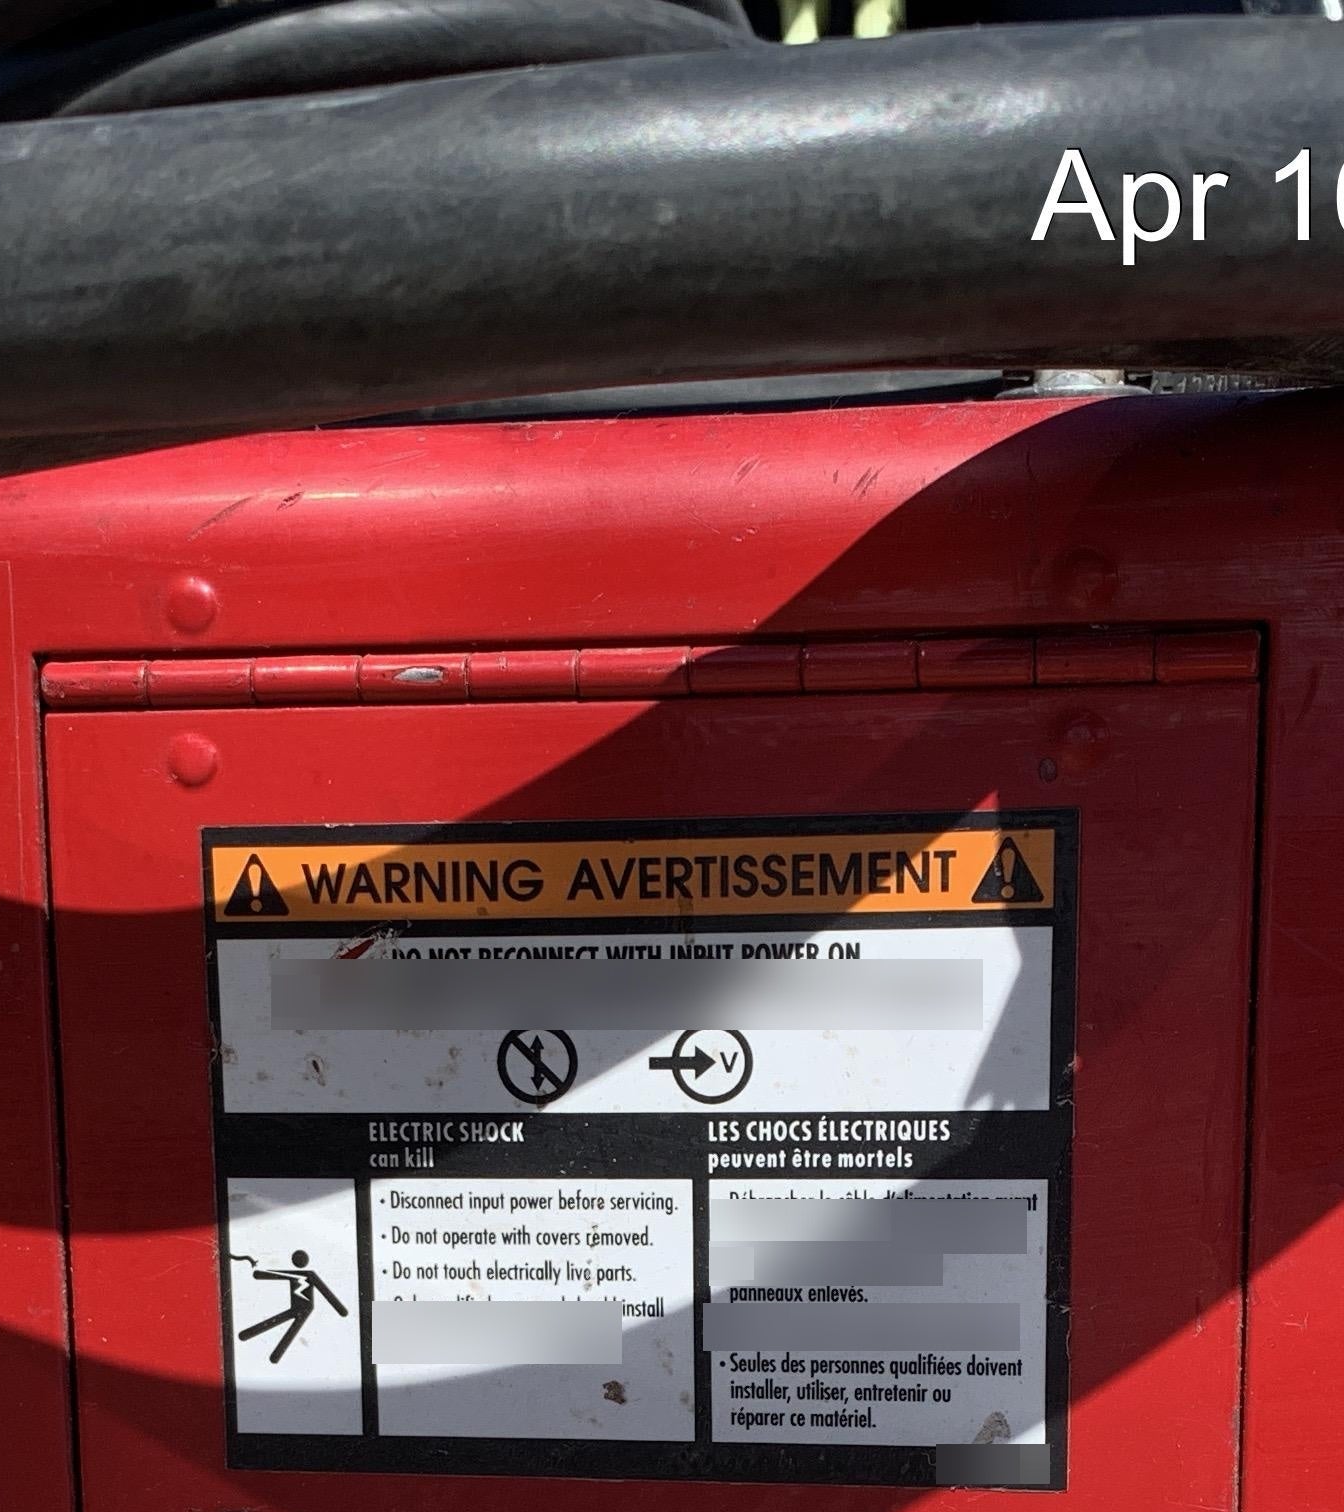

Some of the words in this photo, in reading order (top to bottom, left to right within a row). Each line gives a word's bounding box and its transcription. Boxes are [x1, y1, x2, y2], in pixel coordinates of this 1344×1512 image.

[301, 859, 545, 905] WARNING
[567, 850, 958, 901] AVERTISSEMENT
[369, 1122, 453, 1142] ELECTRIC
[459, 1122, 525, 1142] SHOCK
[708, 1120, 740, 1141] LES
[746, 1120, 812, 1141] CHOCS
[818, 1116, 951, 1142] ÉLECTRIQUES
[370, 1154, 399, 1167] can
[405, 1147, 434, 1168] kill
[708, 1150, 786, 1173] peuvent
[792, 1149, 832, 1168] être
[838, 1147, 913, 1168] mortels
[390, 1191, 464, 1210] Disconnect
[469, 1191, 505, 1214] input
[510, 1194, 553, 1214] power
[559, 1189, 605, 1210] before
[610, 1191, 679, 1215] servicing.
[391, 1226, 410, 1246] Do
[416, 1228, 437, 1246] not
[443, 1228, 496, 1249] operate
[501, 1225, 531, 1246] with
[536, 1230, 580, 1246] covers
[586, 1225, 654, 1247] removed.
[392, 1261, 411, 1280] Do
[417, 1263, 439, 1280] not
[444, 1261, 481, 1280] touch
[486, 1260, 561, 1285] electrically
[566, 1262, 592, 1281] live
[596, 1264, 637, 1285] parts.
[729, 1286, 803, 1303] panneaux
[622, 1297, 665, 1318] install
[729, 1352, 776, 1373] Seules
[781, 1351, 806, 1373] des
[810, 1357, 885, 1378] personnes
[889, 1353, 962, 1379] qualifiées
[966, 1354, 1023, 1377] doivent
[730, 1379, 791, 1404] installer,
[796, 1380, 848, 1405] utiliser,
[854, 1383, 928, 1402] entretenir
[932, 1386, 951, 1402] ou
[730, 1407, 785, 1430] réparer
[790, 1410, 806, 1427] ce
[810, 1406, 876, 1428] matériel.
